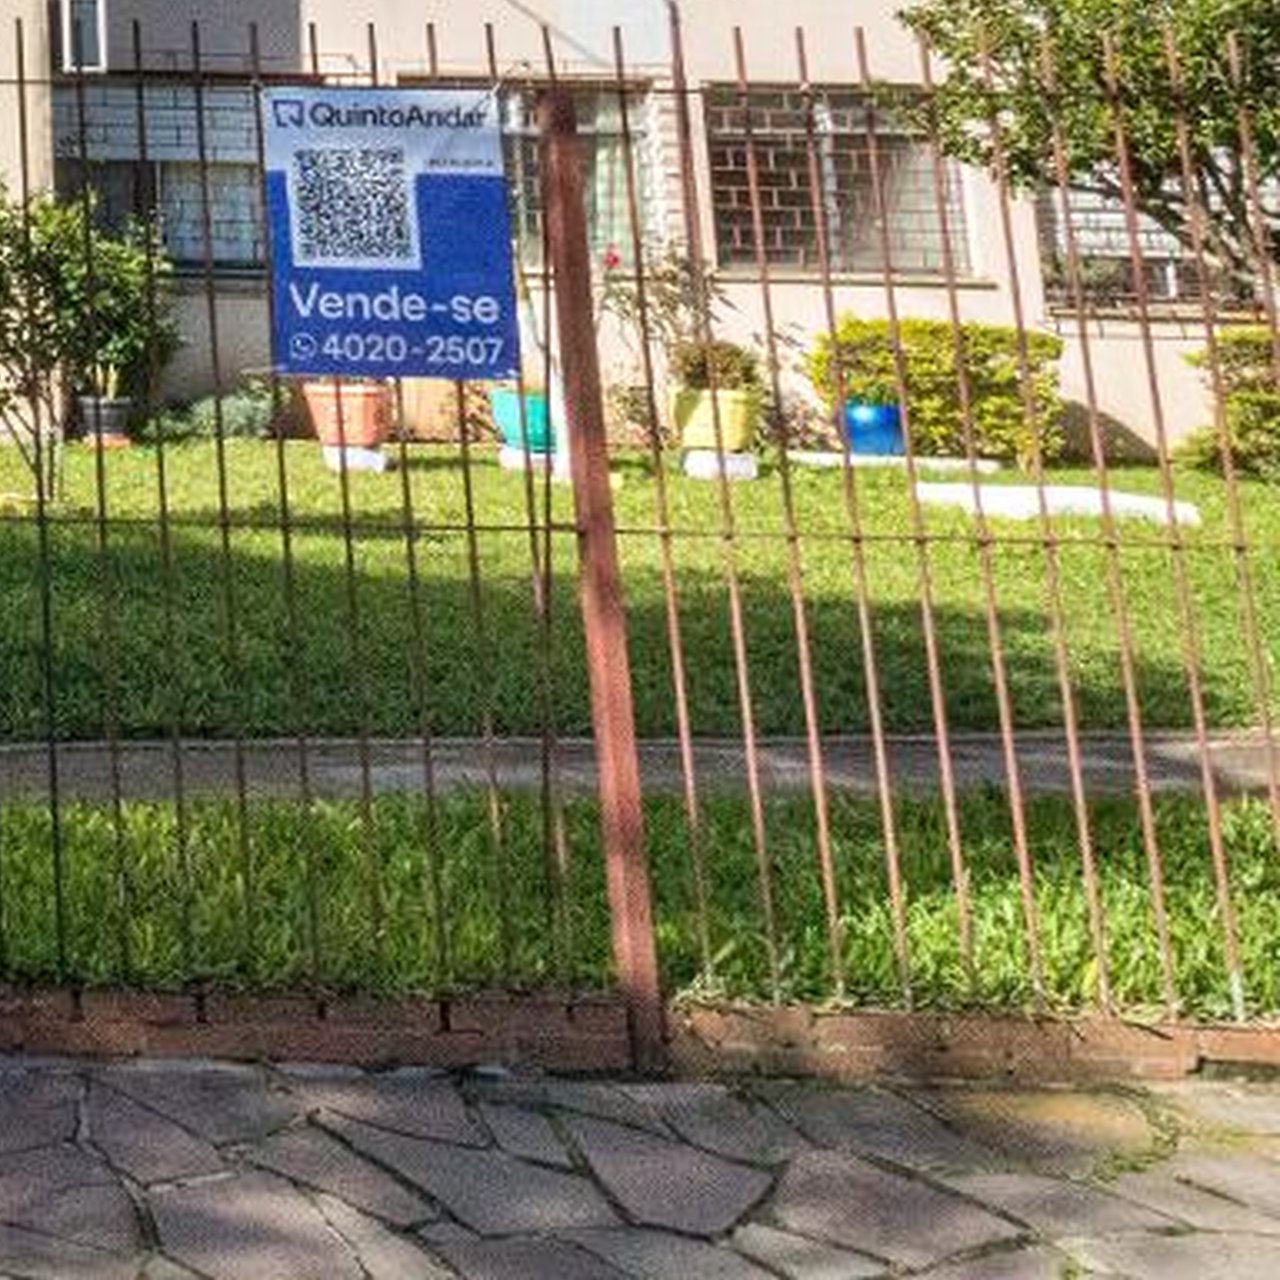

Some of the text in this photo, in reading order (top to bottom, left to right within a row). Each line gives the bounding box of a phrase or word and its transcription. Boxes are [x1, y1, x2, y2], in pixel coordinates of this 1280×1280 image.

[308, 101, 487, 128] QuintoAndar
[289, 281, 500, 324] Vende-se
[322, 333, 504, 365] 4020-2507
